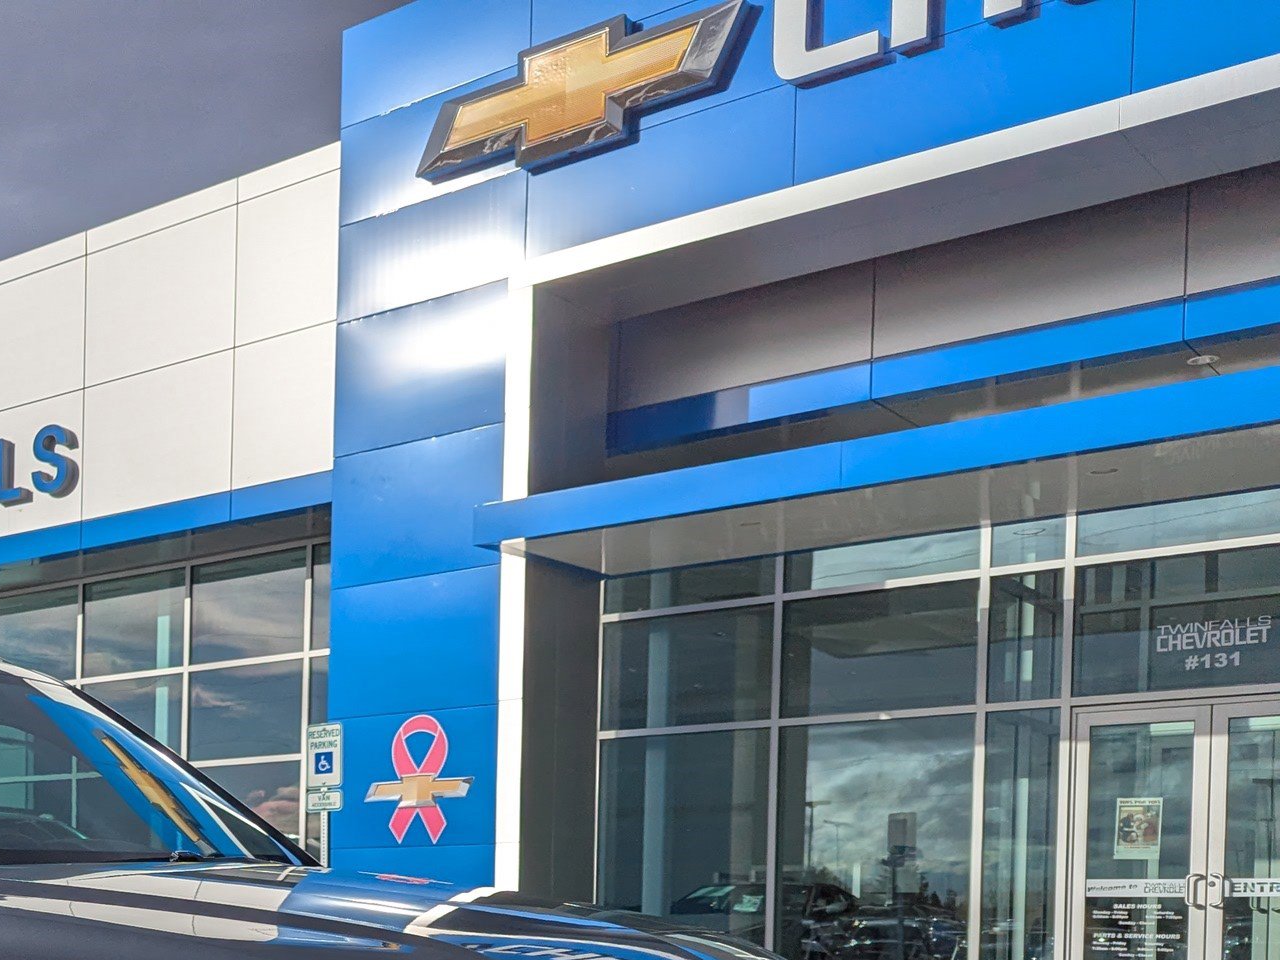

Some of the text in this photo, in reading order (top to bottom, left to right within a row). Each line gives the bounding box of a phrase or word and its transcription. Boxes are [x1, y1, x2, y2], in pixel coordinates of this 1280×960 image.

[1157, 615, 1271, 635] TWINFALLS
[1156, 626, 1271, 652] CHEVROLET
[1185, 651, 1241, 671] #131
[308, 728, 340, 740] RESERVED
[310, 739, 338, 751] PARKING
[317, 794, 331, 802] VAN
